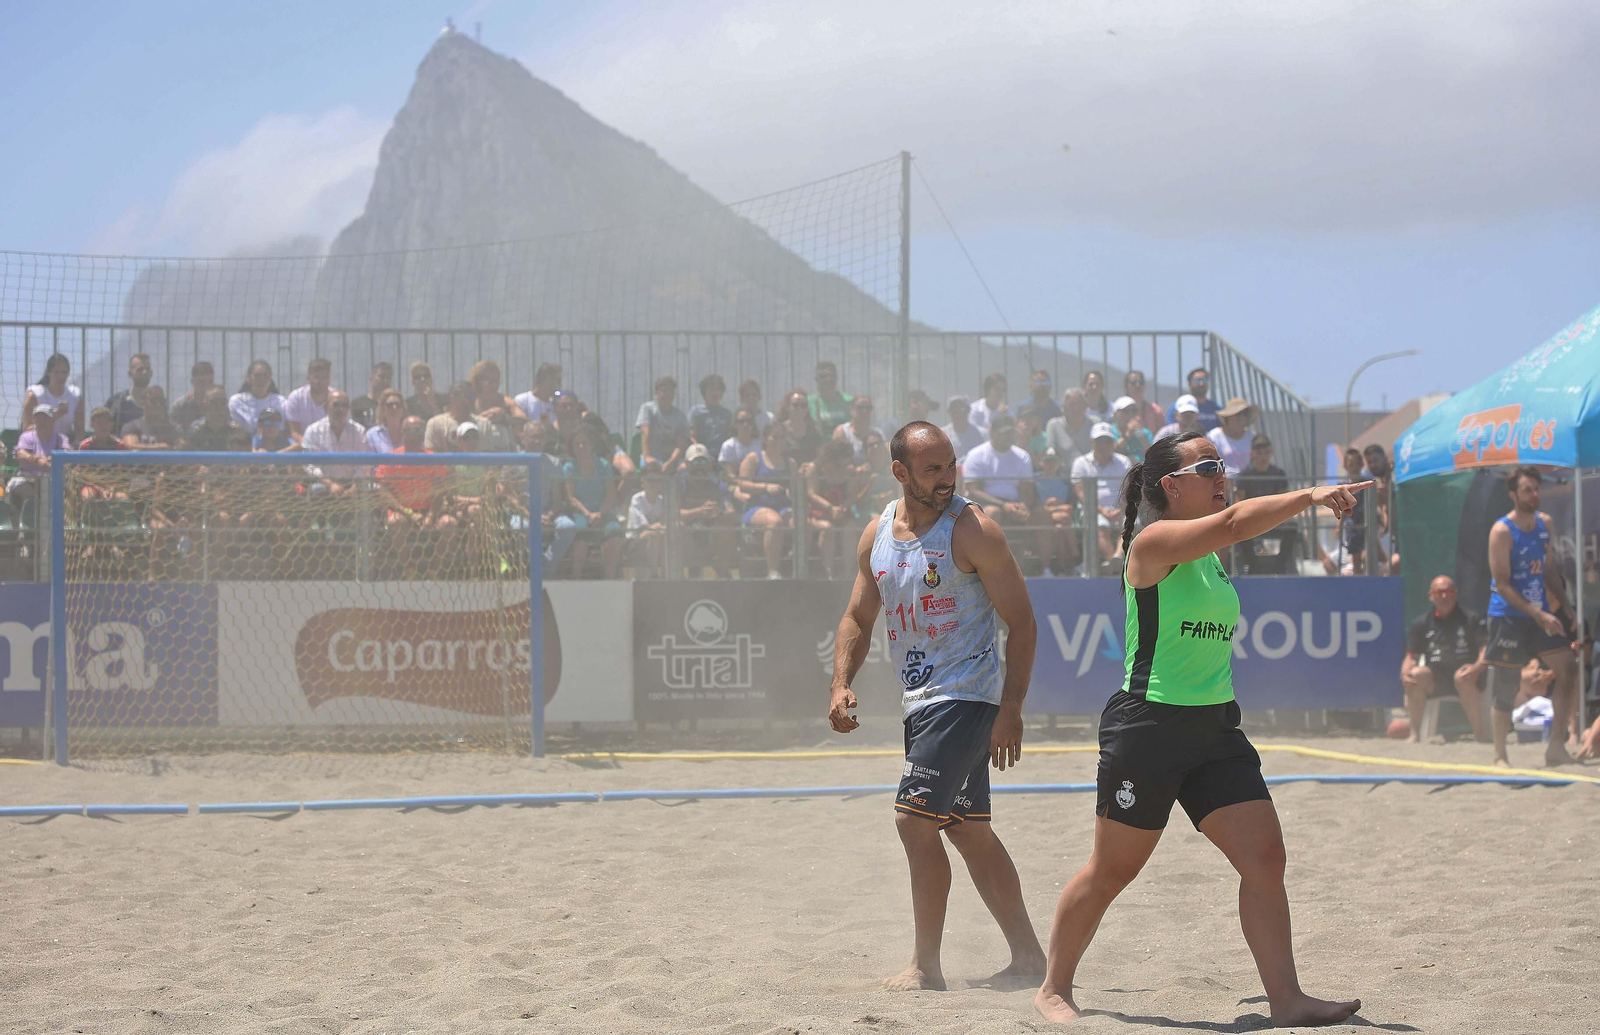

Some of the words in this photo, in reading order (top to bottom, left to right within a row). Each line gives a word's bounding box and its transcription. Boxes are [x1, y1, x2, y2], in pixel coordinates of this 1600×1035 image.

[1530, 559, 1542, 574] 22
[895, 602, 918, 632] 11
[913, 765, 940, 777] CANTABRIA
